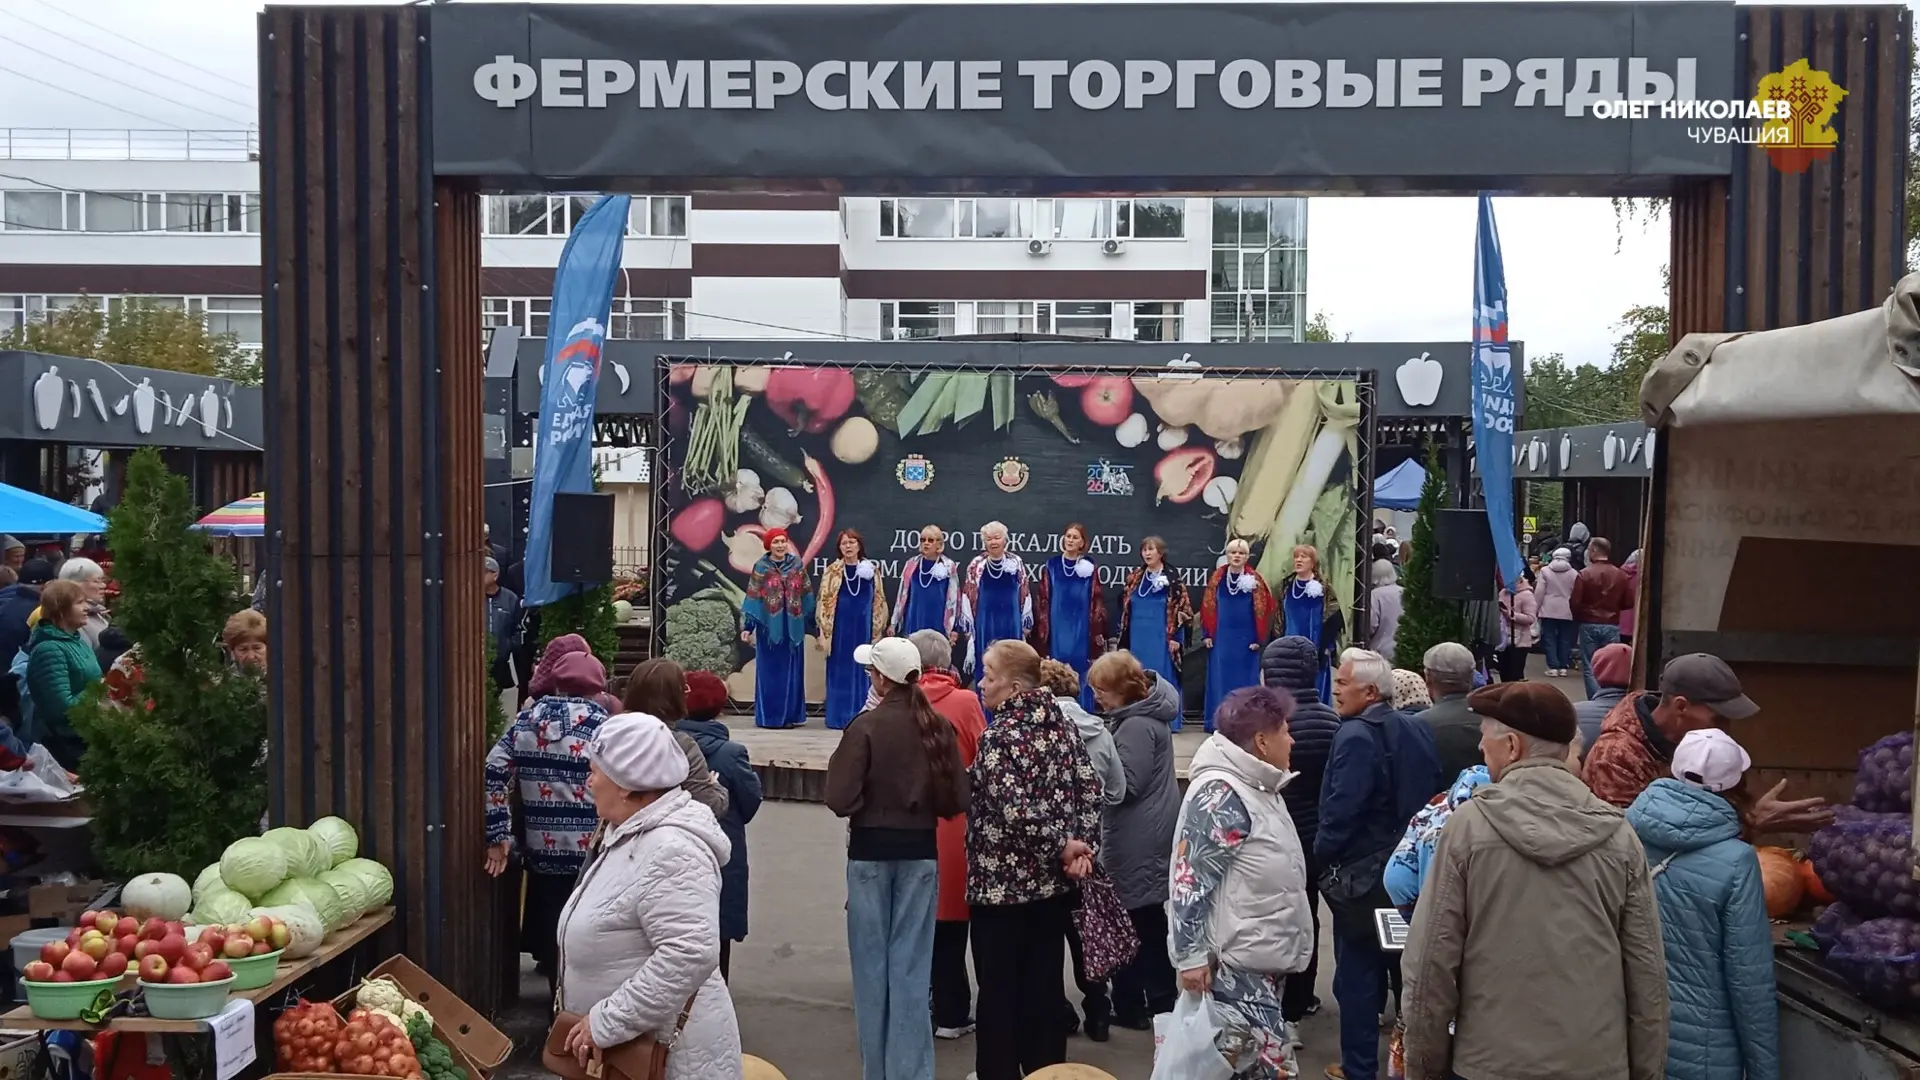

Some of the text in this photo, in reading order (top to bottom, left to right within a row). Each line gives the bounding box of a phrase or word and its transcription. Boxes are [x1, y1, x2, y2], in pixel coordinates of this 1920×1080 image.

[473, 55, 1696, 118] ФЕРМЕРСКИЕ ТОРГОВЫЕ РЯДЫ
[1087, 480, 1104, 492] 26
[890, 529, 1132, 555] ДОО ПЖАЛАТЬ
